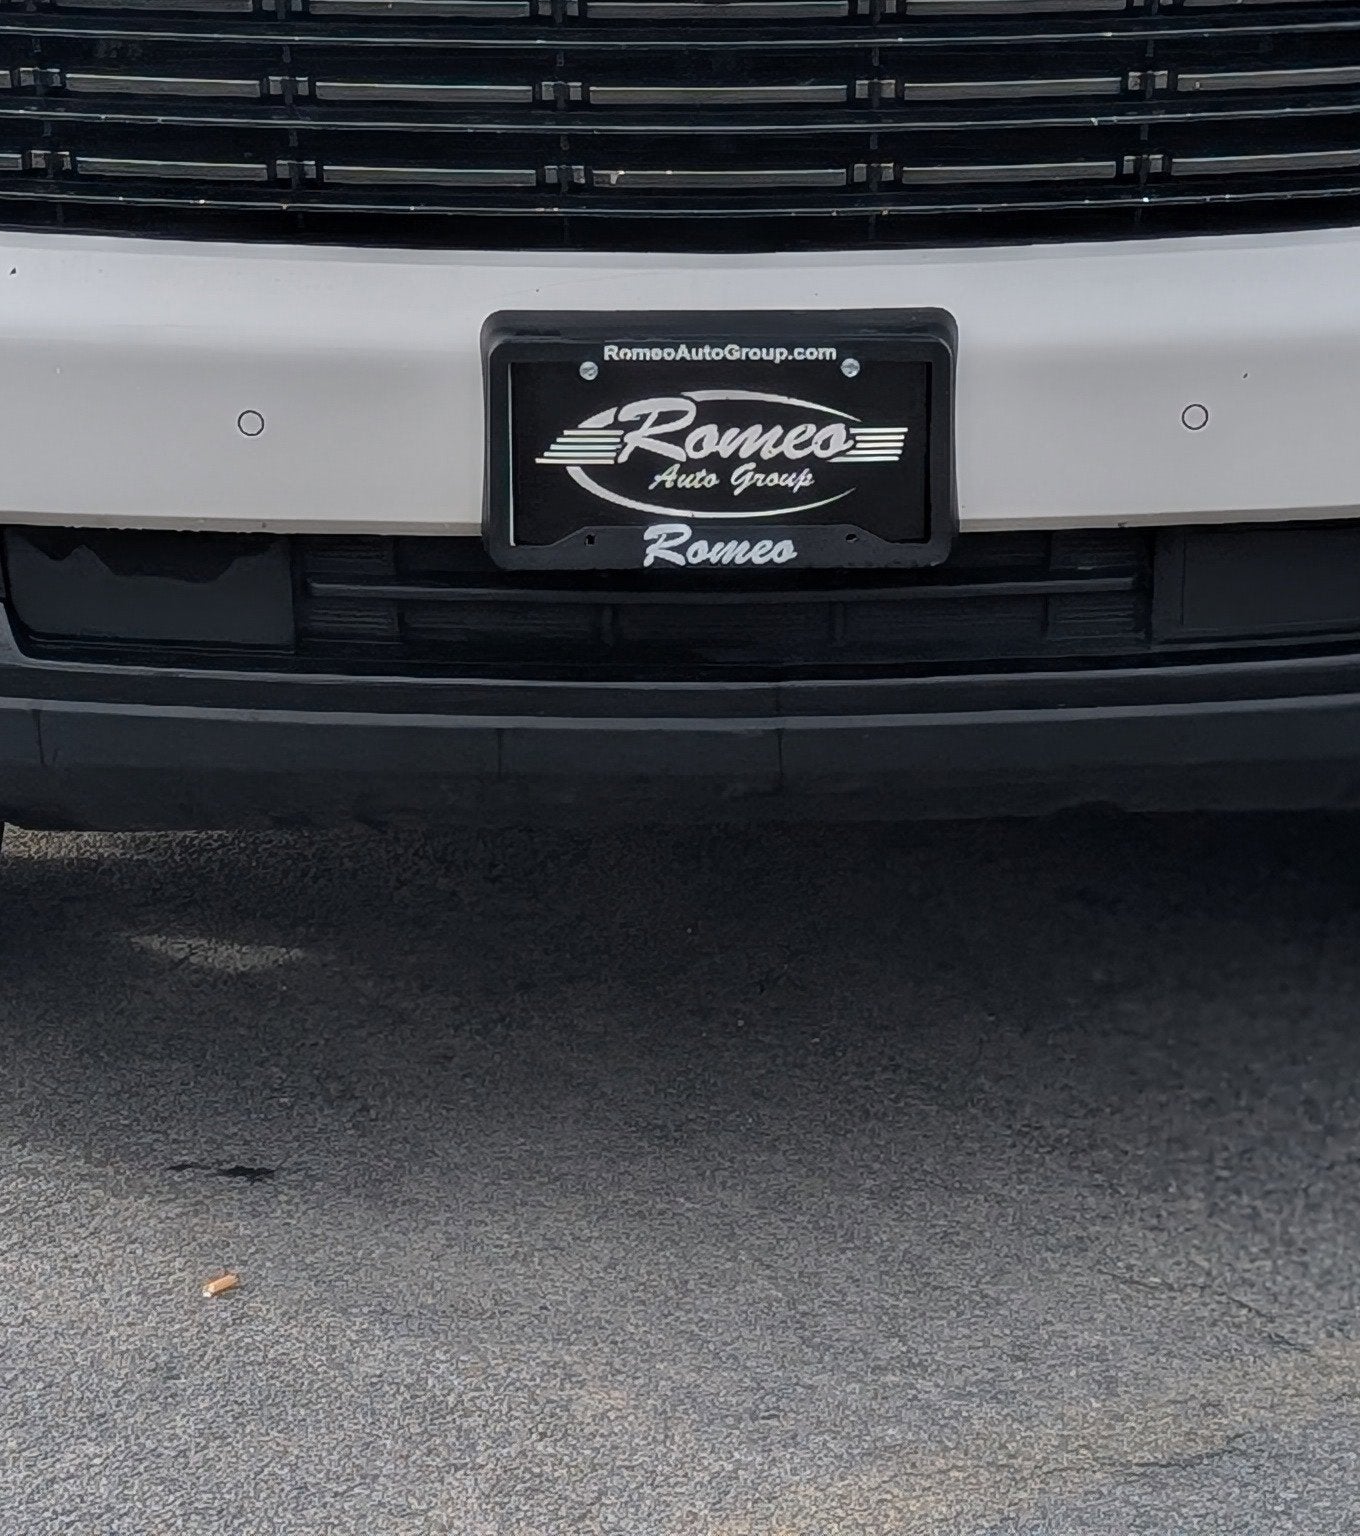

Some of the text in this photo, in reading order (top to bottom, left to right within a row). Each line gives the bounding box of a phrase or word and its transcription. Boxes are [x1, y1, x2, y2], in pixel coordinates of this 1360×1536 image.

[603, 344, 838, 364] RomeoAutoGroup.com
[616, 396, 855, 464] Romeo
[648, 462, 816, 495] Auto Group
[642, 522, 799, 568] Romeo
